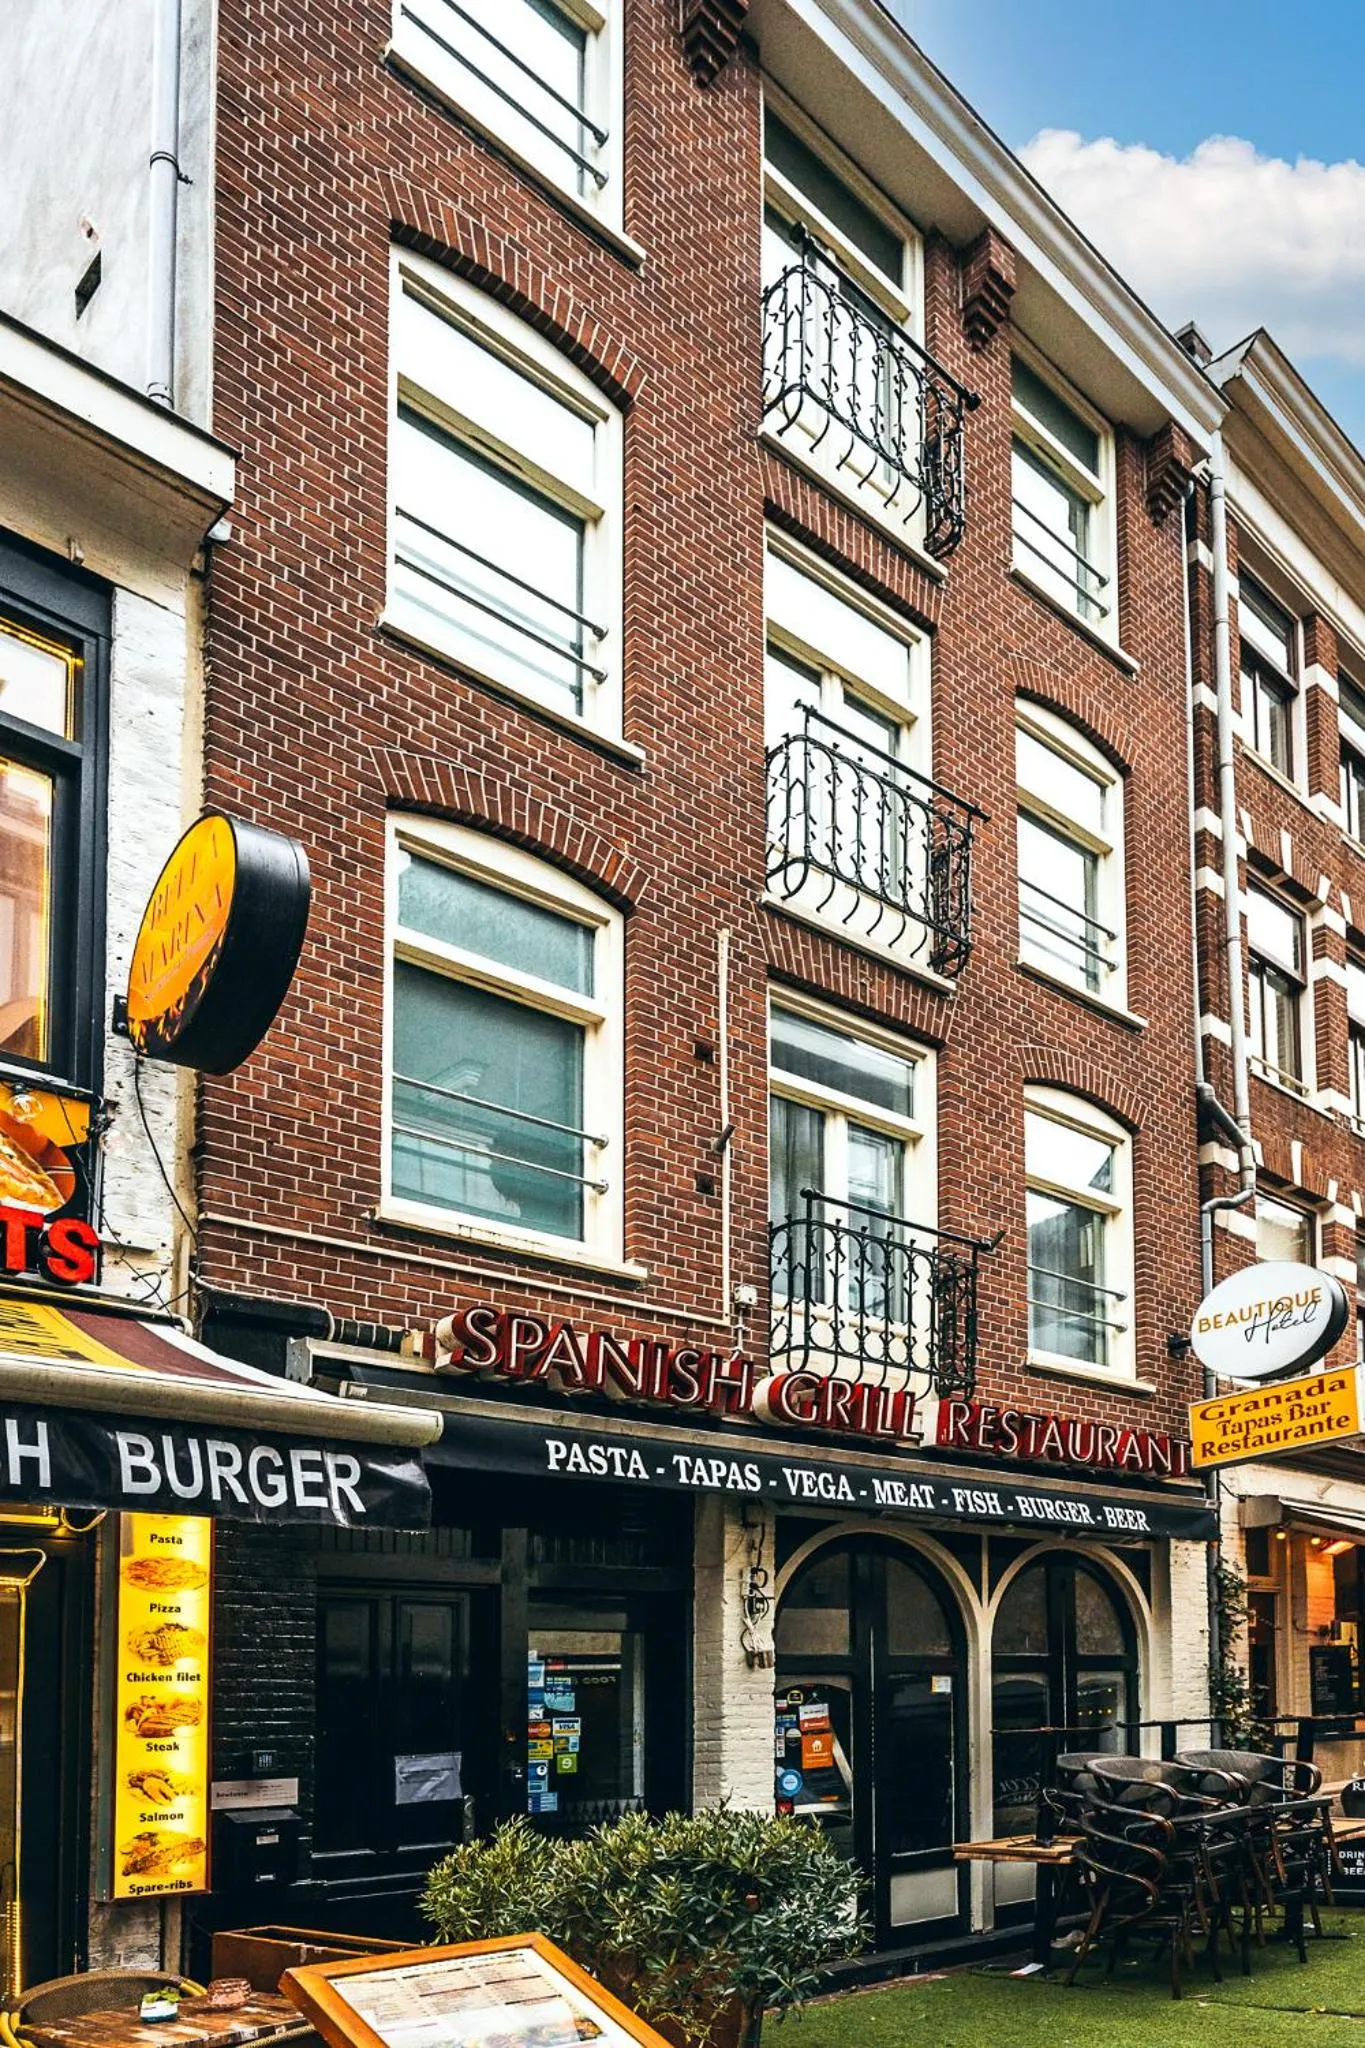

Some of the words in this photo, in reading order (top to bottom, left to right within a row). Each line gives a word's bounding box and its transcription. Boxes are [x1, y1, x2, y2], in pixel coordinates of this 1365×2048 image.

[1198, 1286, 1323, 1334] BEAUTIQUE
[450, 1305, 753, 1415] SPANISH
[767, 1370, 925, 1443] GRILL
[938, 1399, 1194, 1477] RESTAURANT
[1199, 1376, 1348, 1421] Granada
[1200, 1414, 1351, 1459] Restaurante
[1216, 1412, 1283, 1439] Tapas
[1286, 1400, 1332, 1423] Bar
[5, 1419, 51, 1488] H
[116, 1431, 367, 1513] BURGER
[545, 1439, 650, 1480] PASTA
[672, 1455, 761, 1492] TAPAS
[782, 1468, 856, 1502] VEGA
[872, 1478, 937, 1509] MEAT
[952, 1488, 1006, 1516] FISH
[1015, 1495, 1096, 1526] BURGER
[1104, 1506, 1152, 1532] BEER
[150, 1533, 184, 1545] Pasta
[149, 1603, 182, 1614] Pizza
[126, 1672, 173, 1683] Chicken
[176, 1672, 201, 1682] filet
[146, 1741, 180, 1752] Steak
[139, 1811, 184, 1823] Salmon
[128, 1879, 193, 1896] Spare-ribs
